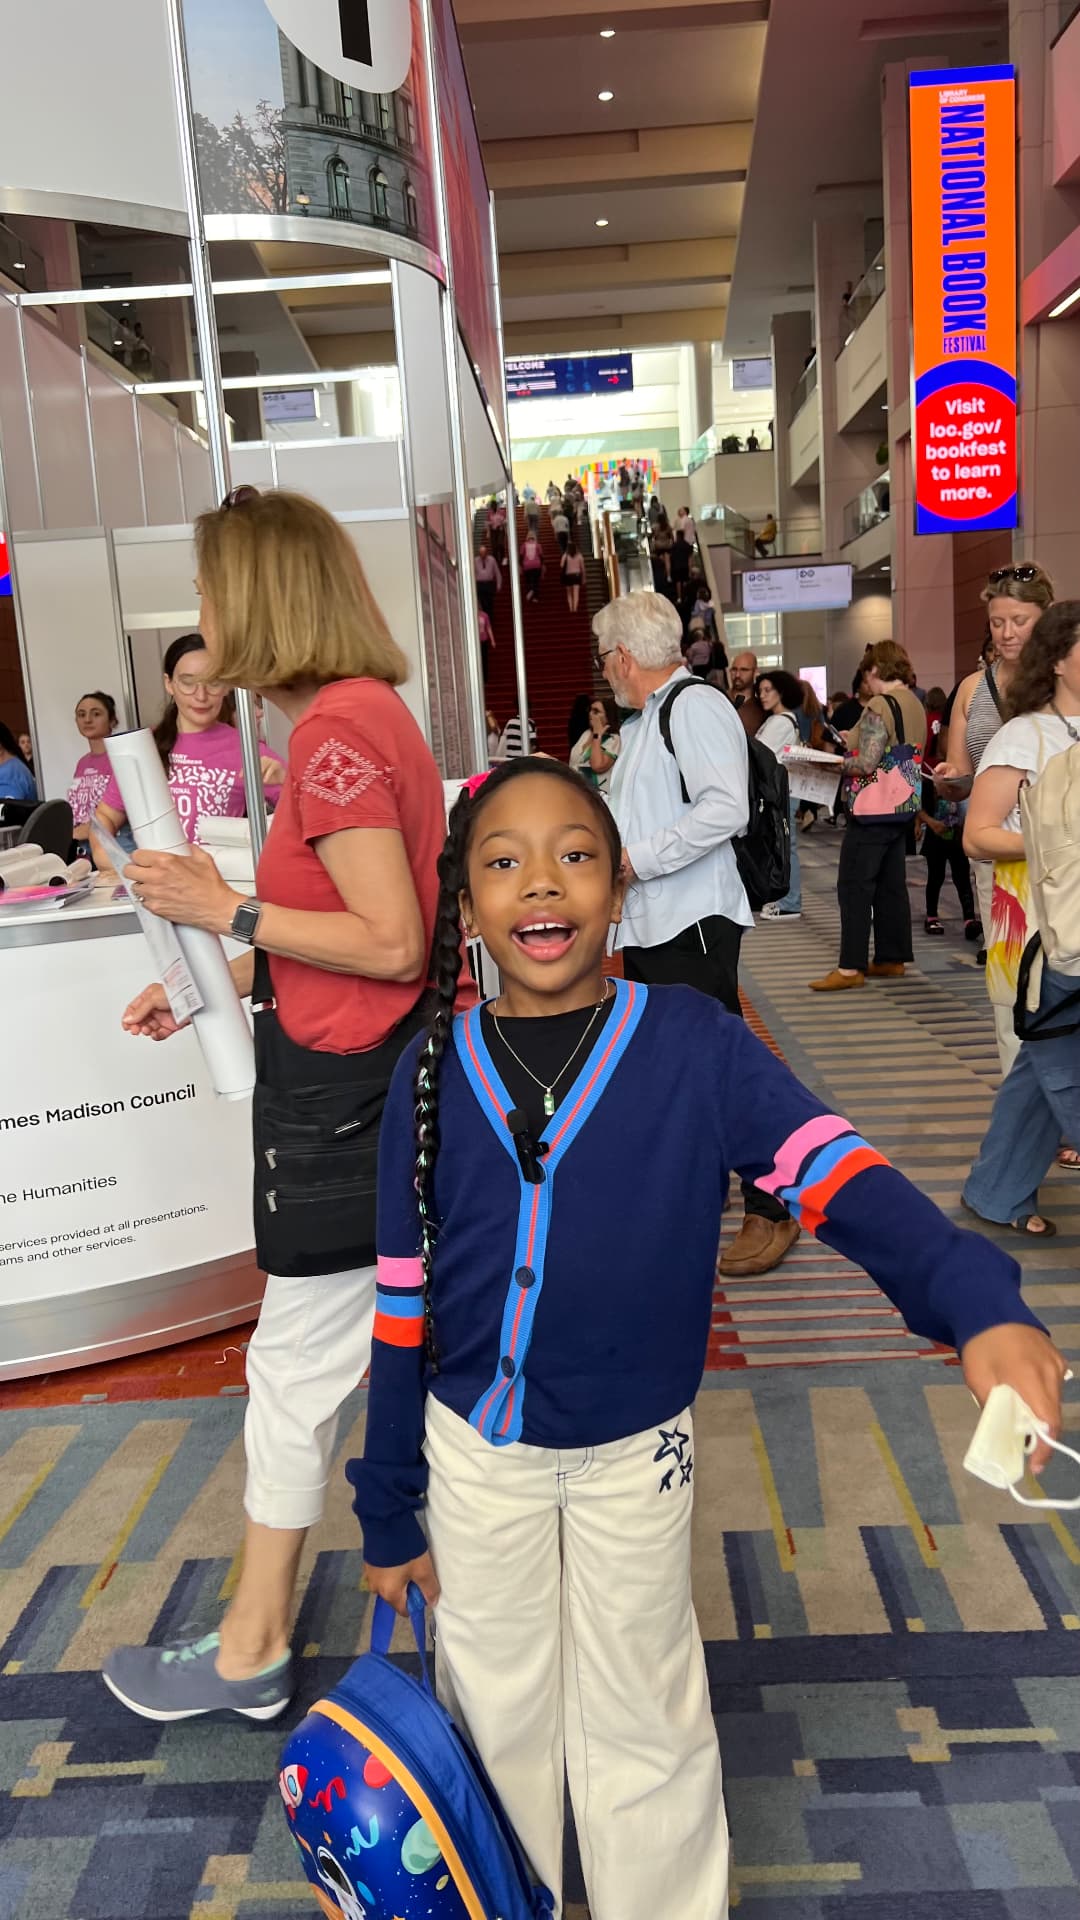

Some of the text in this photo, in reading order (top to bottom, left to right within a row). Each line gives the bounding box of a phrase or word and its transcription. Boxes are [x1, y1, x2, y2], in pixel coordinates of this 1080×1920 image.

[940, 103, 987, 333] NATIONAL BOOK
[943, 335, 986, 353] FESTIVAL
[945, 397, 985, 415] Visit
[930, 419, 1001, 440] loc.gov/
[926, 440, 1006, 460] bookfest
[931, 463, 1001, 480] to learn
[940, 486, 992, 502] more.
[46, 1099, 125, 1124] Madison
[131, 1083, 196, 1109] Council
[23, 1174, 118, 1201] Humanities
[0, 1202, 209, 1251] services provided at all presentations.
[27, 1250, 50, 1263] and
[52, 1244, 83, 1258] other
[86, 1235, 137, 1252] services.
